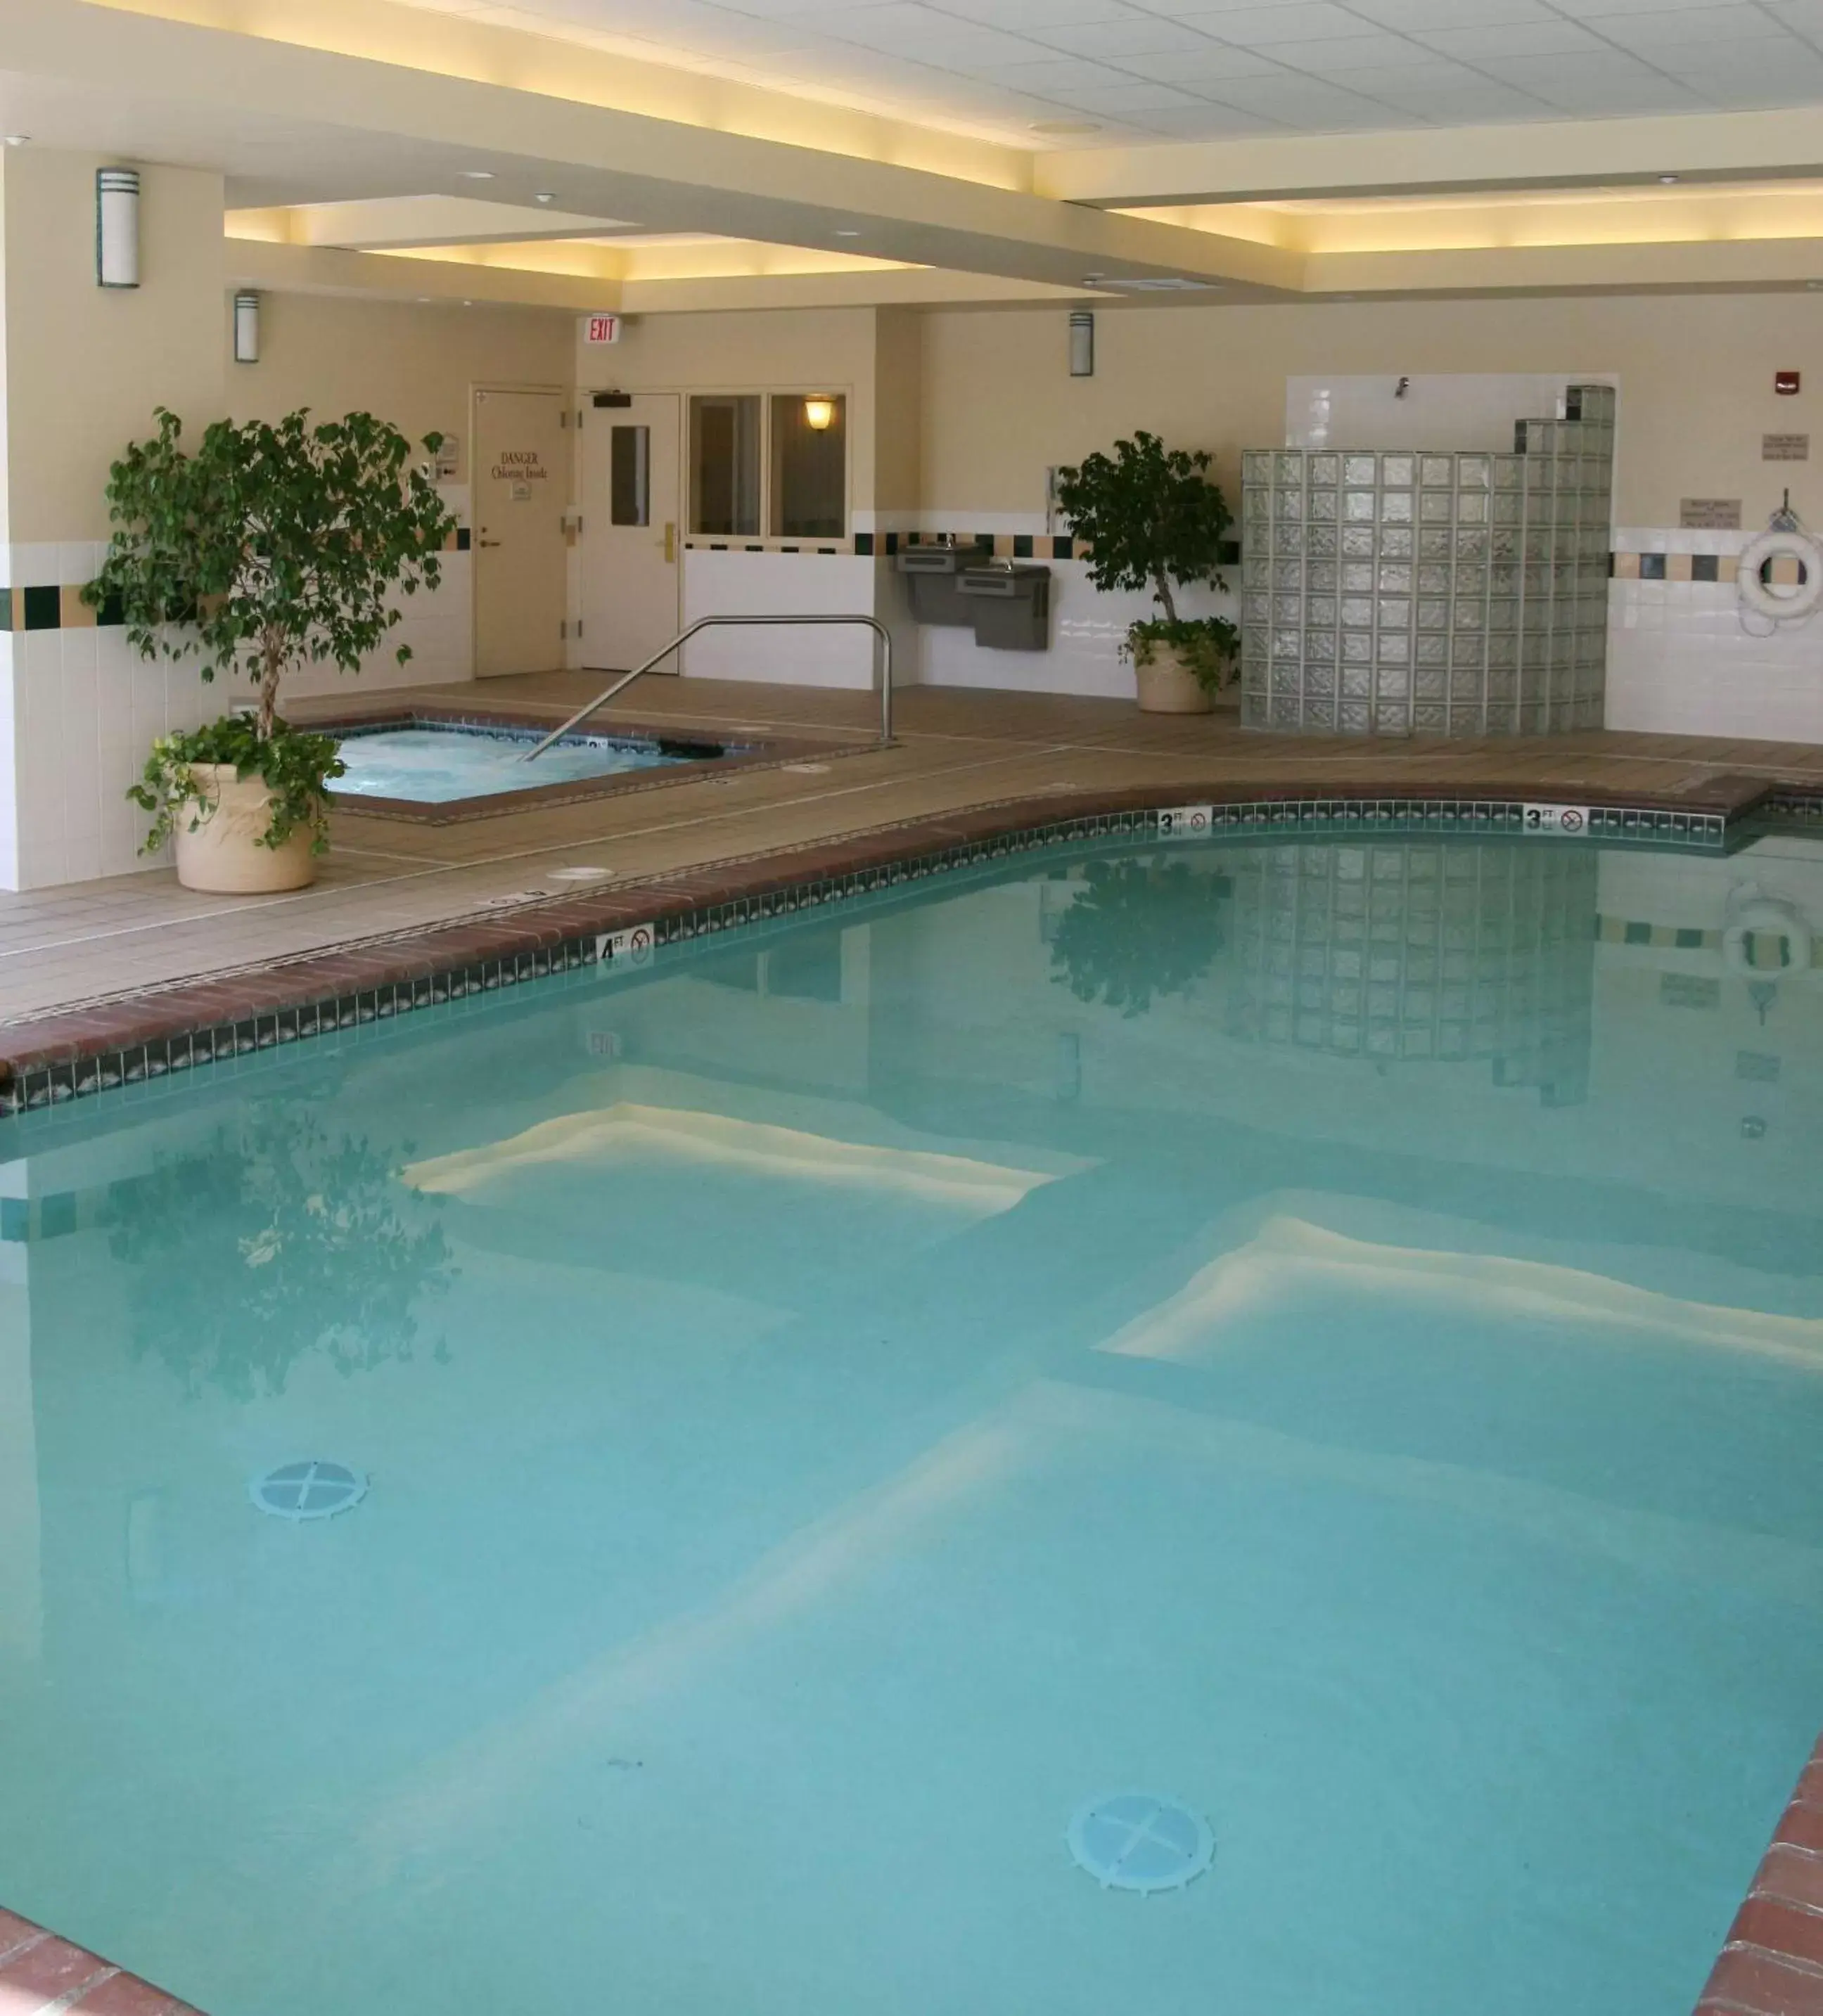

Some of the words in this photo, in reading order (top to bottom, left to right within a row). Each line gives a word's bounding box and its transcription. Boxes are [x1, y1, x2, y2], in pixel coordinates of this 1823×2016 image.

[590, 318, 615, 341] EXIT
[501, 452, 538, 465] DANGER
[601, 938, 613, 959] 4
